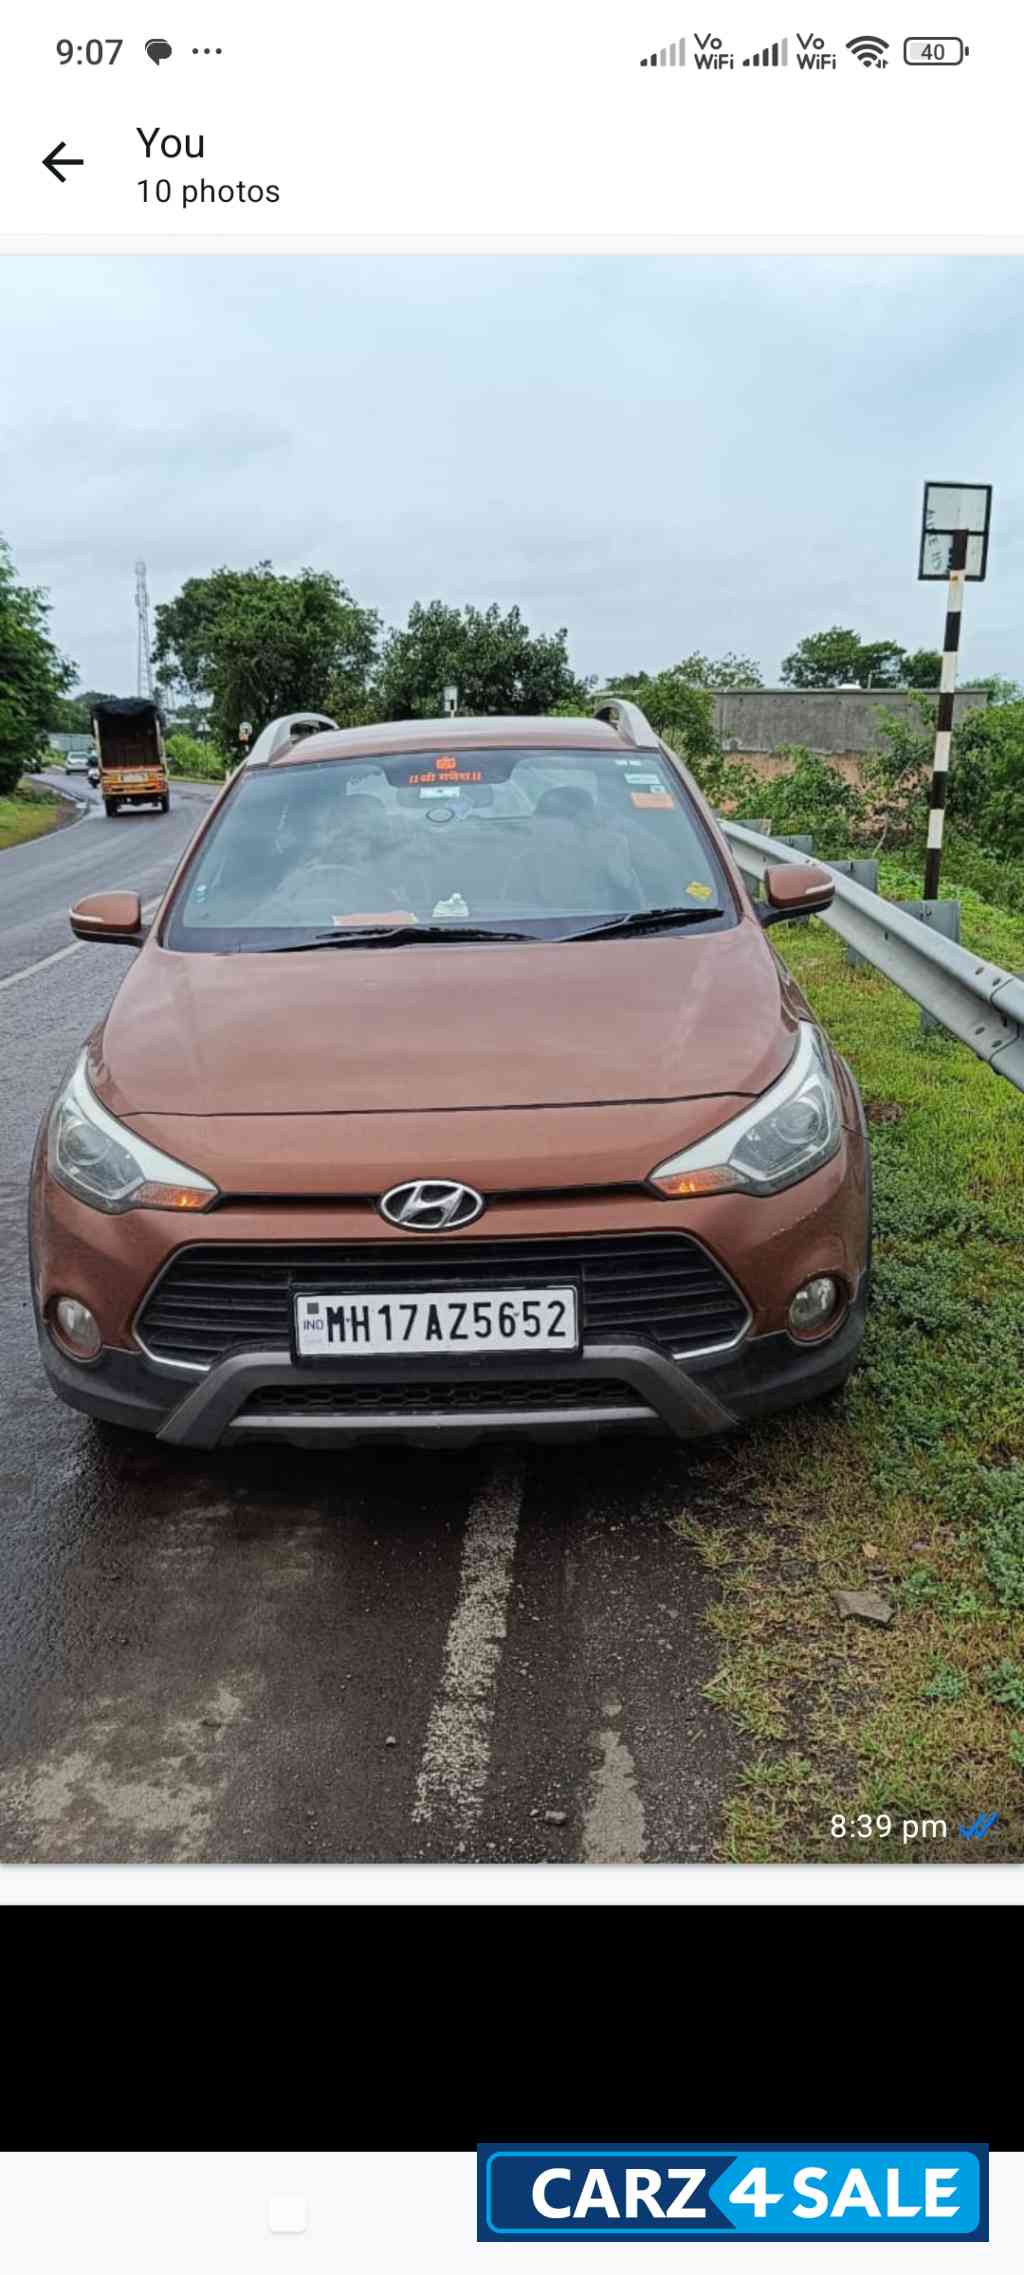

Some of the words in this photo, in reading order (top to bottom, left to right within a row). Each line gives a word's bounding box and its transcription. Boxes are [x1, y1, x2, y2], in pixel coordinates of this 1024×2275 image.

[694, 33, 722, 49] Vo
[797, 33, 824, 49] Vo
[57, 39, 123, 65] 9:07
[921, 44, 944, 60] 40
[694, 54, 733, 69] WiFi
[797, 54, 836, 69] WiFi
[136, 128, 203, 158] You
[138, 179, 170, 202] 10
[183, 178, 279, 208] photos
[327, 1301, 565, 1342] MH17AZ5652
